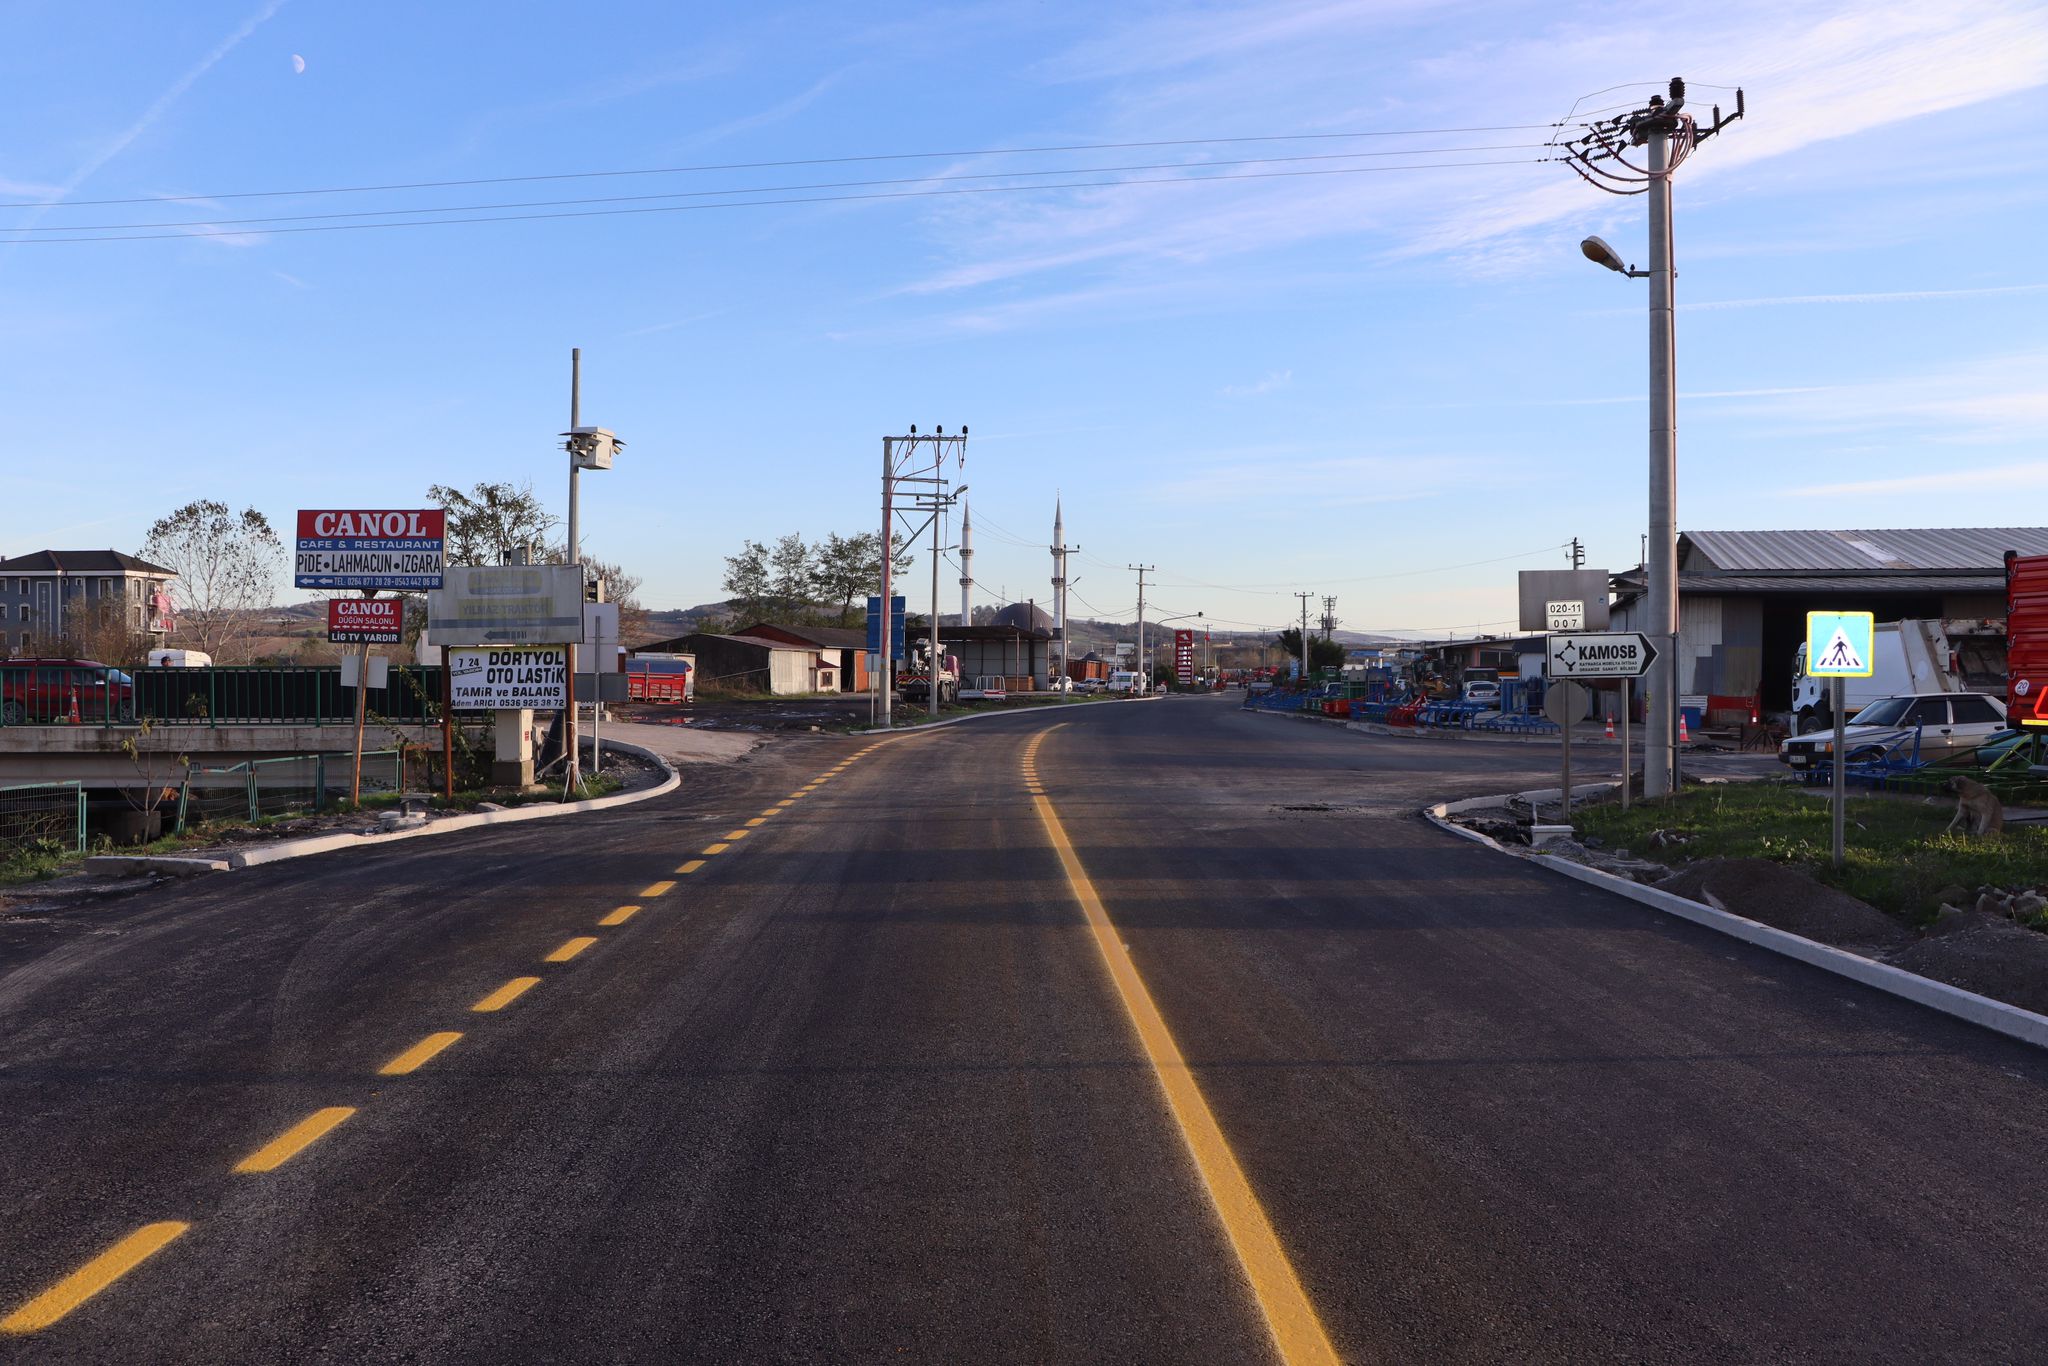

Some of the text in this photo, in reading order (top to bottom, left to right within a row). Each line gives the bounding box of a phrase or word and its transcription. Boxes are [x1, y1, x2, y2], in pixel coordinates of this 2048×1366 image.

[314, 512, 426, 537] CANOL
[299, 540, 440, 549] CAFE & RESTAURANT
[331, 554, 392, 573] LAHMACUN
[401, 554, 441, 573] IZGARA
[337, 602, 394, 615] CANOL
[1550, 604, 1581, 613] 020-11
[338, 615, 395, 625] DÜĞÜN SALONU
[348, 633, 360, 641] TV
[363, 633, 398, 642] VARDIR
[488, 647, 564, 666] DÖRTYOL
[1578, 644, 1637, 660] KAMOSB
[458, 657, 479, 667] 7 24
[486, 667, 514, 684] OTO
[496, 688, 508, 697] ve
[512, 687, 560, 697] BALANS
[451, 699, 564, 707] Adem ARICI 0536 925 38 72
